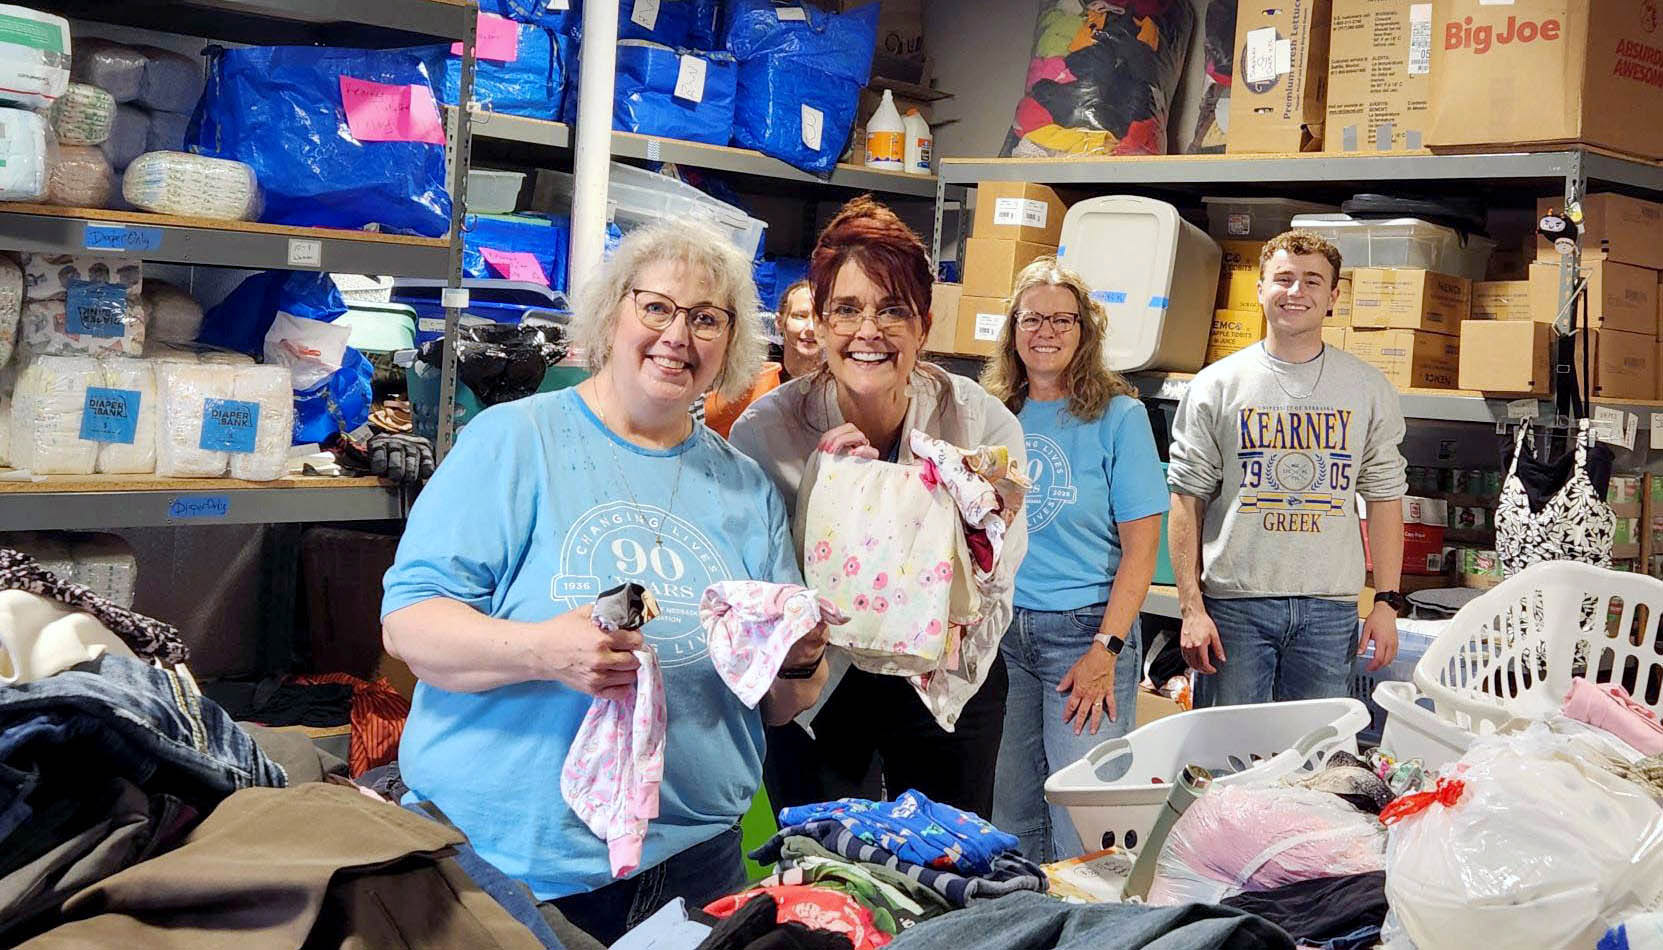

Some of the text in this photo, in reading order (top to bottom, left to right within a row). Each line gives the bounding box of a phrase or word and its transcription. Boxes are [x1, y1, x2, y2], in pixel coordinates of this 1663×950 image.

[1445, 16, 1493, 54] Big
[1496, 16, 1561, 45] Joe
[1284, 70, 1297, 119] Premium
[1291, 0, 1302, 36] Lettuc
[89, 399, 124, 409] DIAPER
[96, 407, 124, 417] BANK
[211, 408, 249, 420] DIAPER
[220, 418, 248, 427] BANK
[1240, 408, 1352, 450] KEARNEY
[1240, 460, 1263, 488] 19
[1330, 462, 1352, 491] 05
[1263, 512, 1322, 533] GREEK
[576, 513, 720, 573] CHANGING LIVES
[611, 538, 685, 581] 90
[563, 581, 591, 590] 1936
